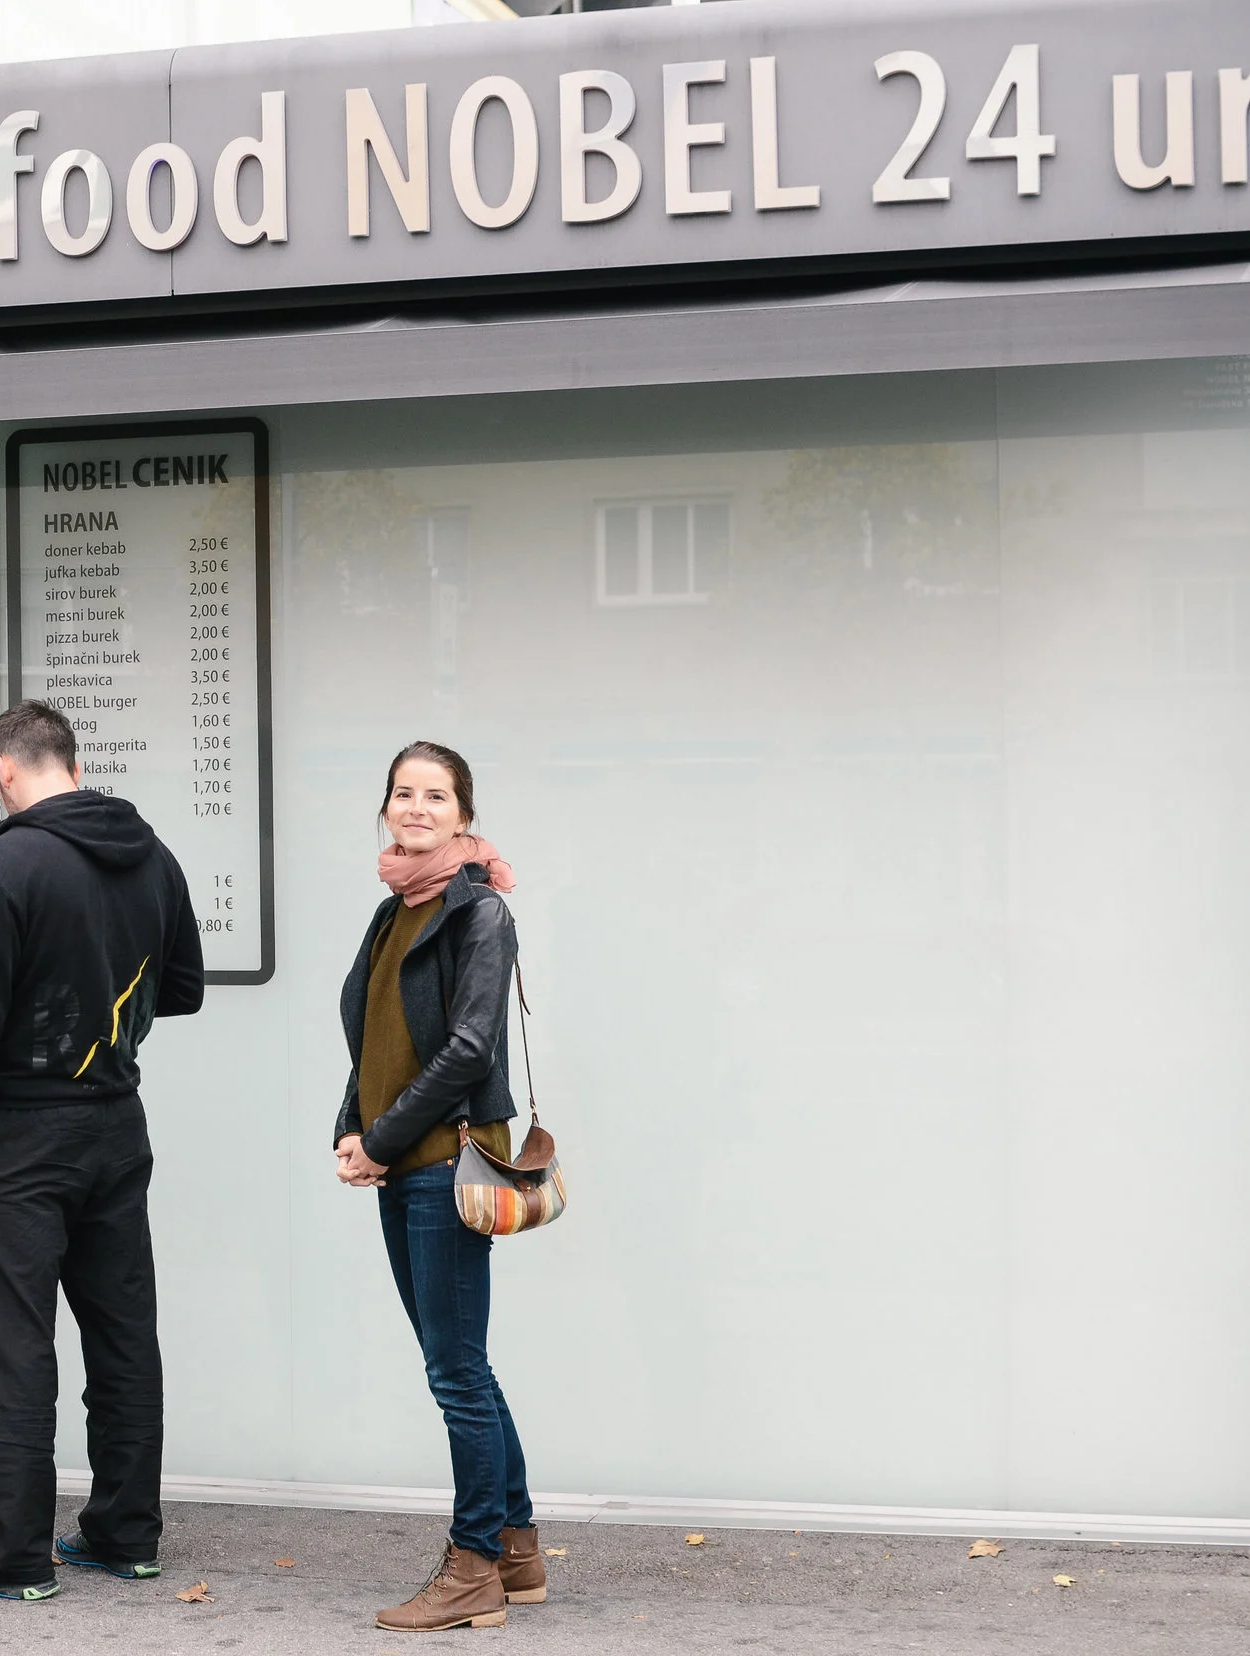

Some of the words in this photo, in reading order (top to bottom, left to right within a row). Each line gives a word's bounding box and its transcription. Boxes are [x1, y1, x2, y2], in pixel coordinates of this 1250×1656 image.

[346, 56, 821, 237] NOBEL
[872, 44, 1056, 203] 24
[45, 511, 118, 533] HRANA
[45, 544, 82, 557] doner
[87, 541, 125, 555] kebab
[190, 538, 216, 552] 2,50
[220, 537, 229, 549] €
[44, 565, 76, 582] jufka
[81, 563, 119, 577] kebab
[190, 560, 216, 574] 3,50
[221, 560, 229, 571] €
[46, 587, 75, 600] sirov
[80, 585, 116, 599] burek
[190, 582, 217, 596] 2,00
[221, 582, 229, 594] €
[46, 609, 85, 622] mesni
[88, 607, 124, 620] burek
[190, 604, 217, 618] 2,00
[221, 604, 229, 616] €
[47, 632, 78, 647] pizza
[83, 629, 119, 642] burek
[191, 626, 217, 640] 2,00
[222, 626, 230, 638] €
[47, 652, 98, 668] špinačni
[103, 650, 140, 663] burek
[191, 648, 218, 662] 2,00
[222, 648, 230, 660] €
[47, 674, 112, 690] pleskavica
[191, 670, 218, 684] 3,50
[222, 670, 230, 682] €
[94, 696, 137, 711] burger
[192, 692, 218, 707] 2,50
[223, 692, 231, 704] €
[73, 718, 96, 733] dog
[193, 715, 218, 728] 1,60
[223, 714, 231, 726] €
[84, 739, 146, 755] margerita
[193, 737, 219, 751] 1,50
[223, 736, 231, 748] €
[85, 761, 126, 774] klasika
[193, 759, 219, 772] 1,70
[224, 759, 231, 770] €
[194, 781, 219, 795] 1,70
[224, 781, 232, 793] €
[194, 803, 220, 817] 1,70
[224, 803, 232, 815] €
[214, 876, 219, 887] 1
[225, 875, 233, 887] €
[214, 898, 220, 909] 1
[225, 897, 233, 909] €
[226, 919, 234, 931] €
